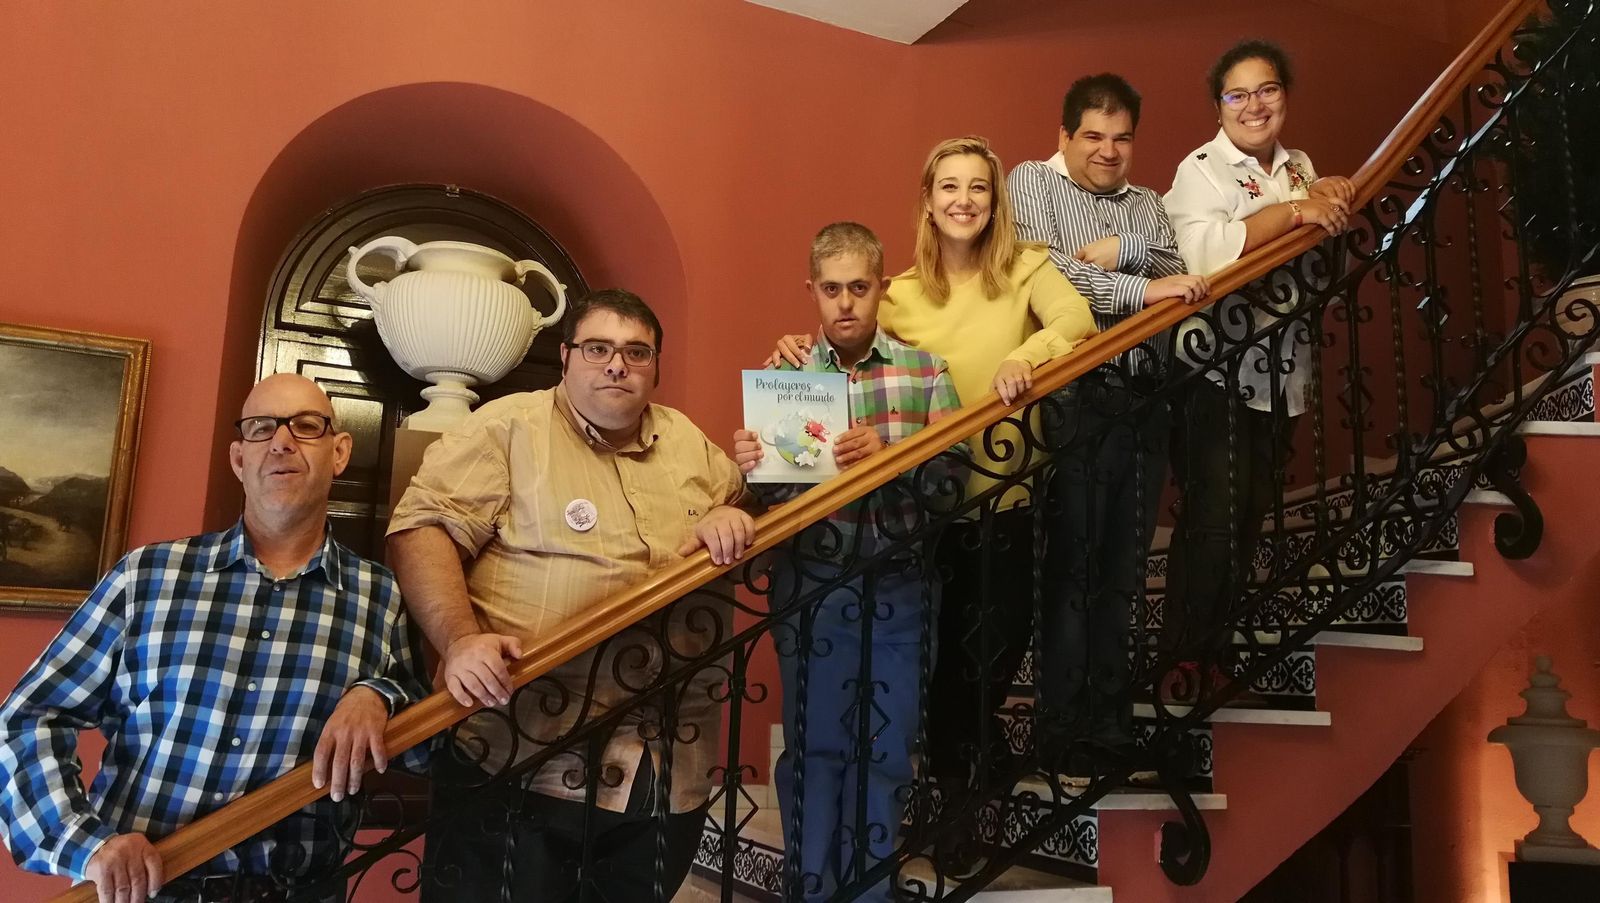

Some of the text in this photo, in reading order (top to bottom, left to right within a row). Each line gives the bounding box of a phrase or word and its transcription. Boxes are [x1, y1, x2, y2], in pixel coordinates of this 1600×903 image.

[755, 378, 811, 393] Prolayeros
[777, 392, 835, 403] por el mundo
